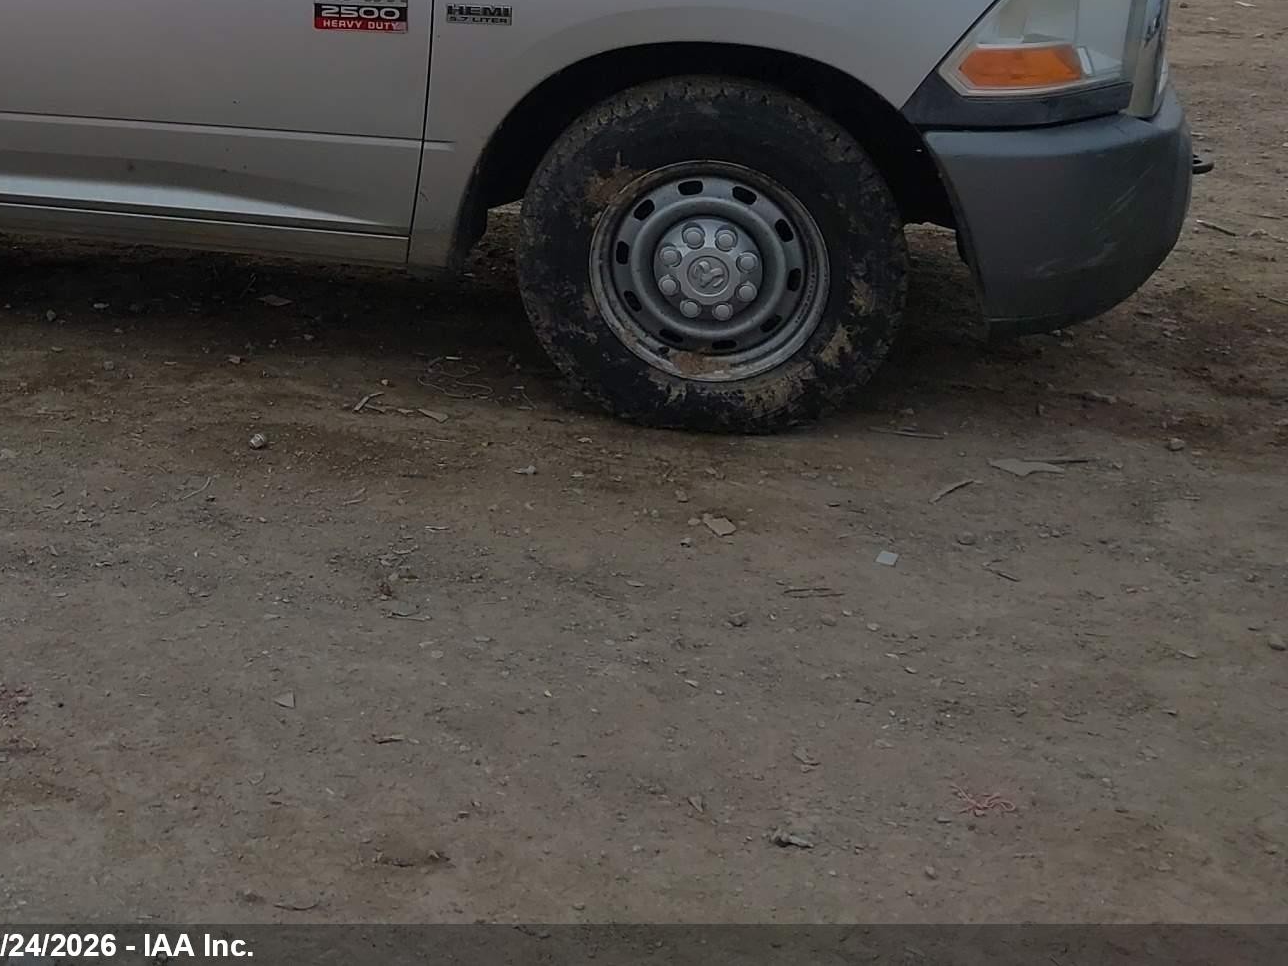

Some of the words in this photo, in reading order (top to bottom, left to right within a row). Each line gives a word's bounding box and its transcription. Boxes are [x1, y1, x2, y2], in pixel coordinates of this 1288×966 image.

[321, 5, 401, 20] 2500
[447, 3, 512, 16] HEMI
[323, 20, 362, 29] HEAVY
[368, 21, 400, 31] DUTY
